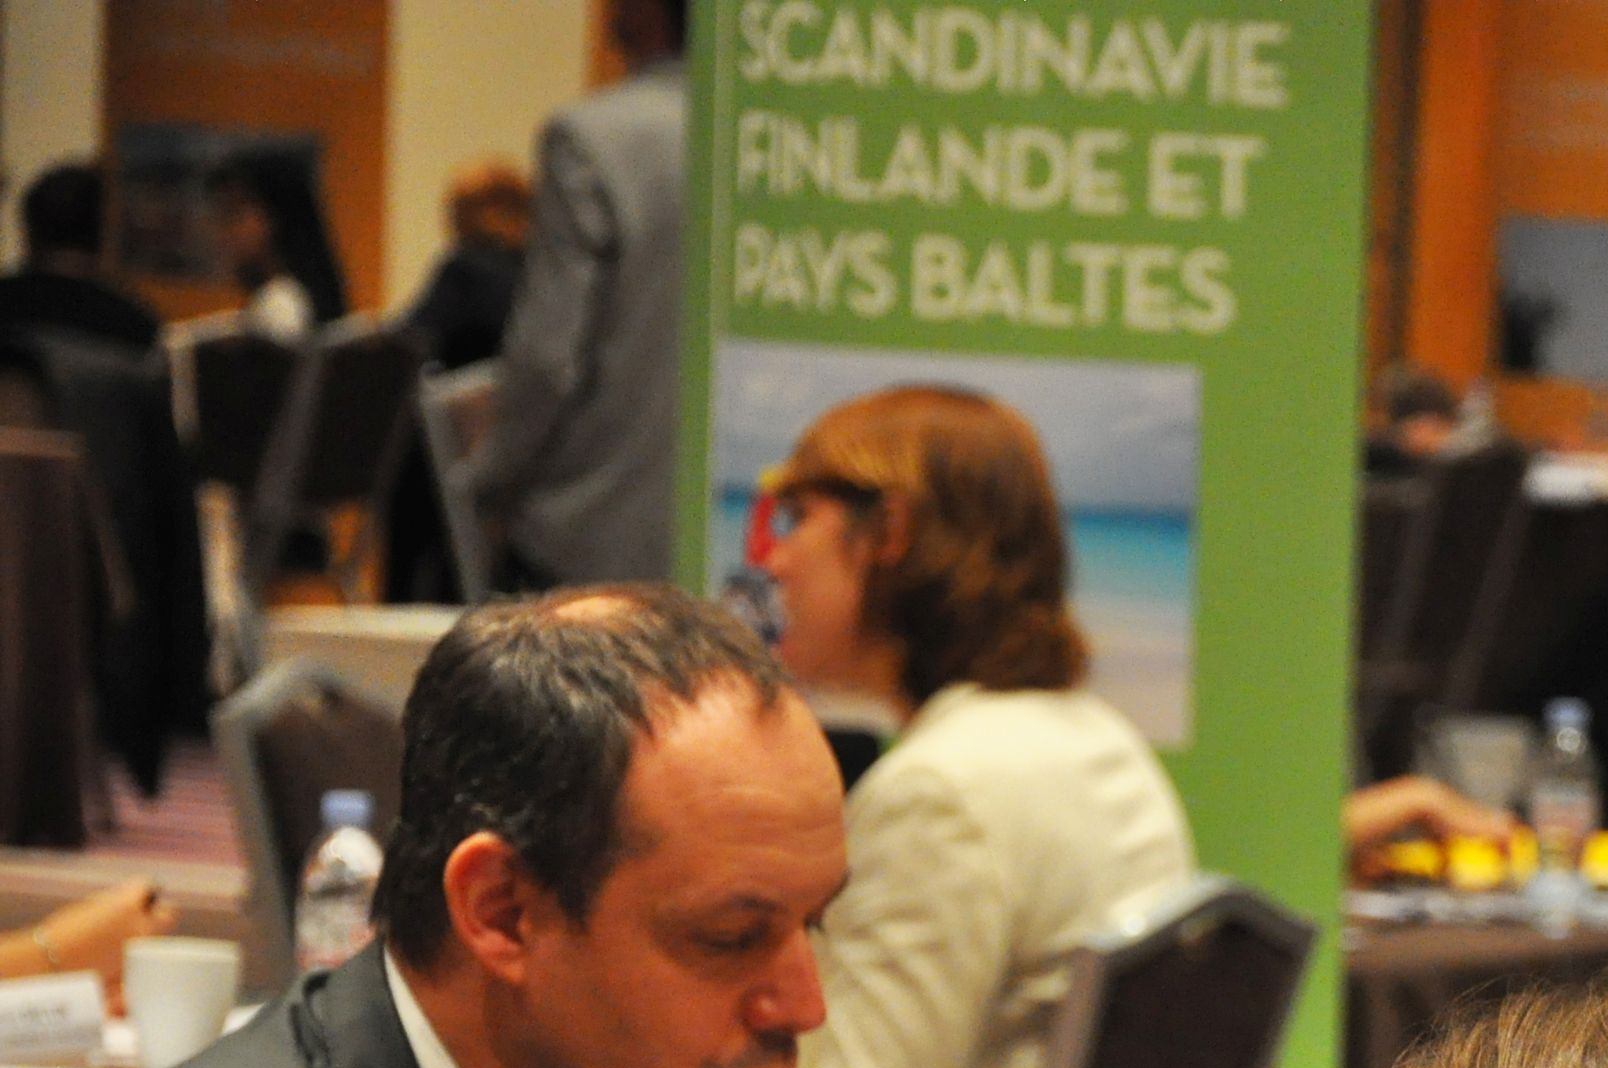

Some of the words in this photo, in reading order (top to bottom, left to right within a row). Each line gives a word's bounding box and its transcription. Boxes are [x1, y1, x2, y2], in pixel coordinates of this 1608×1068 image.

[740, 0, 1292, 108] SCANDINAVIE
[737, 111, 1129, 216] FINLANDE
[1148, 131, 1268, 220] ET
[733, 222, 899, 317] PAYS
[911, 233, 1239, 335] BALTES
